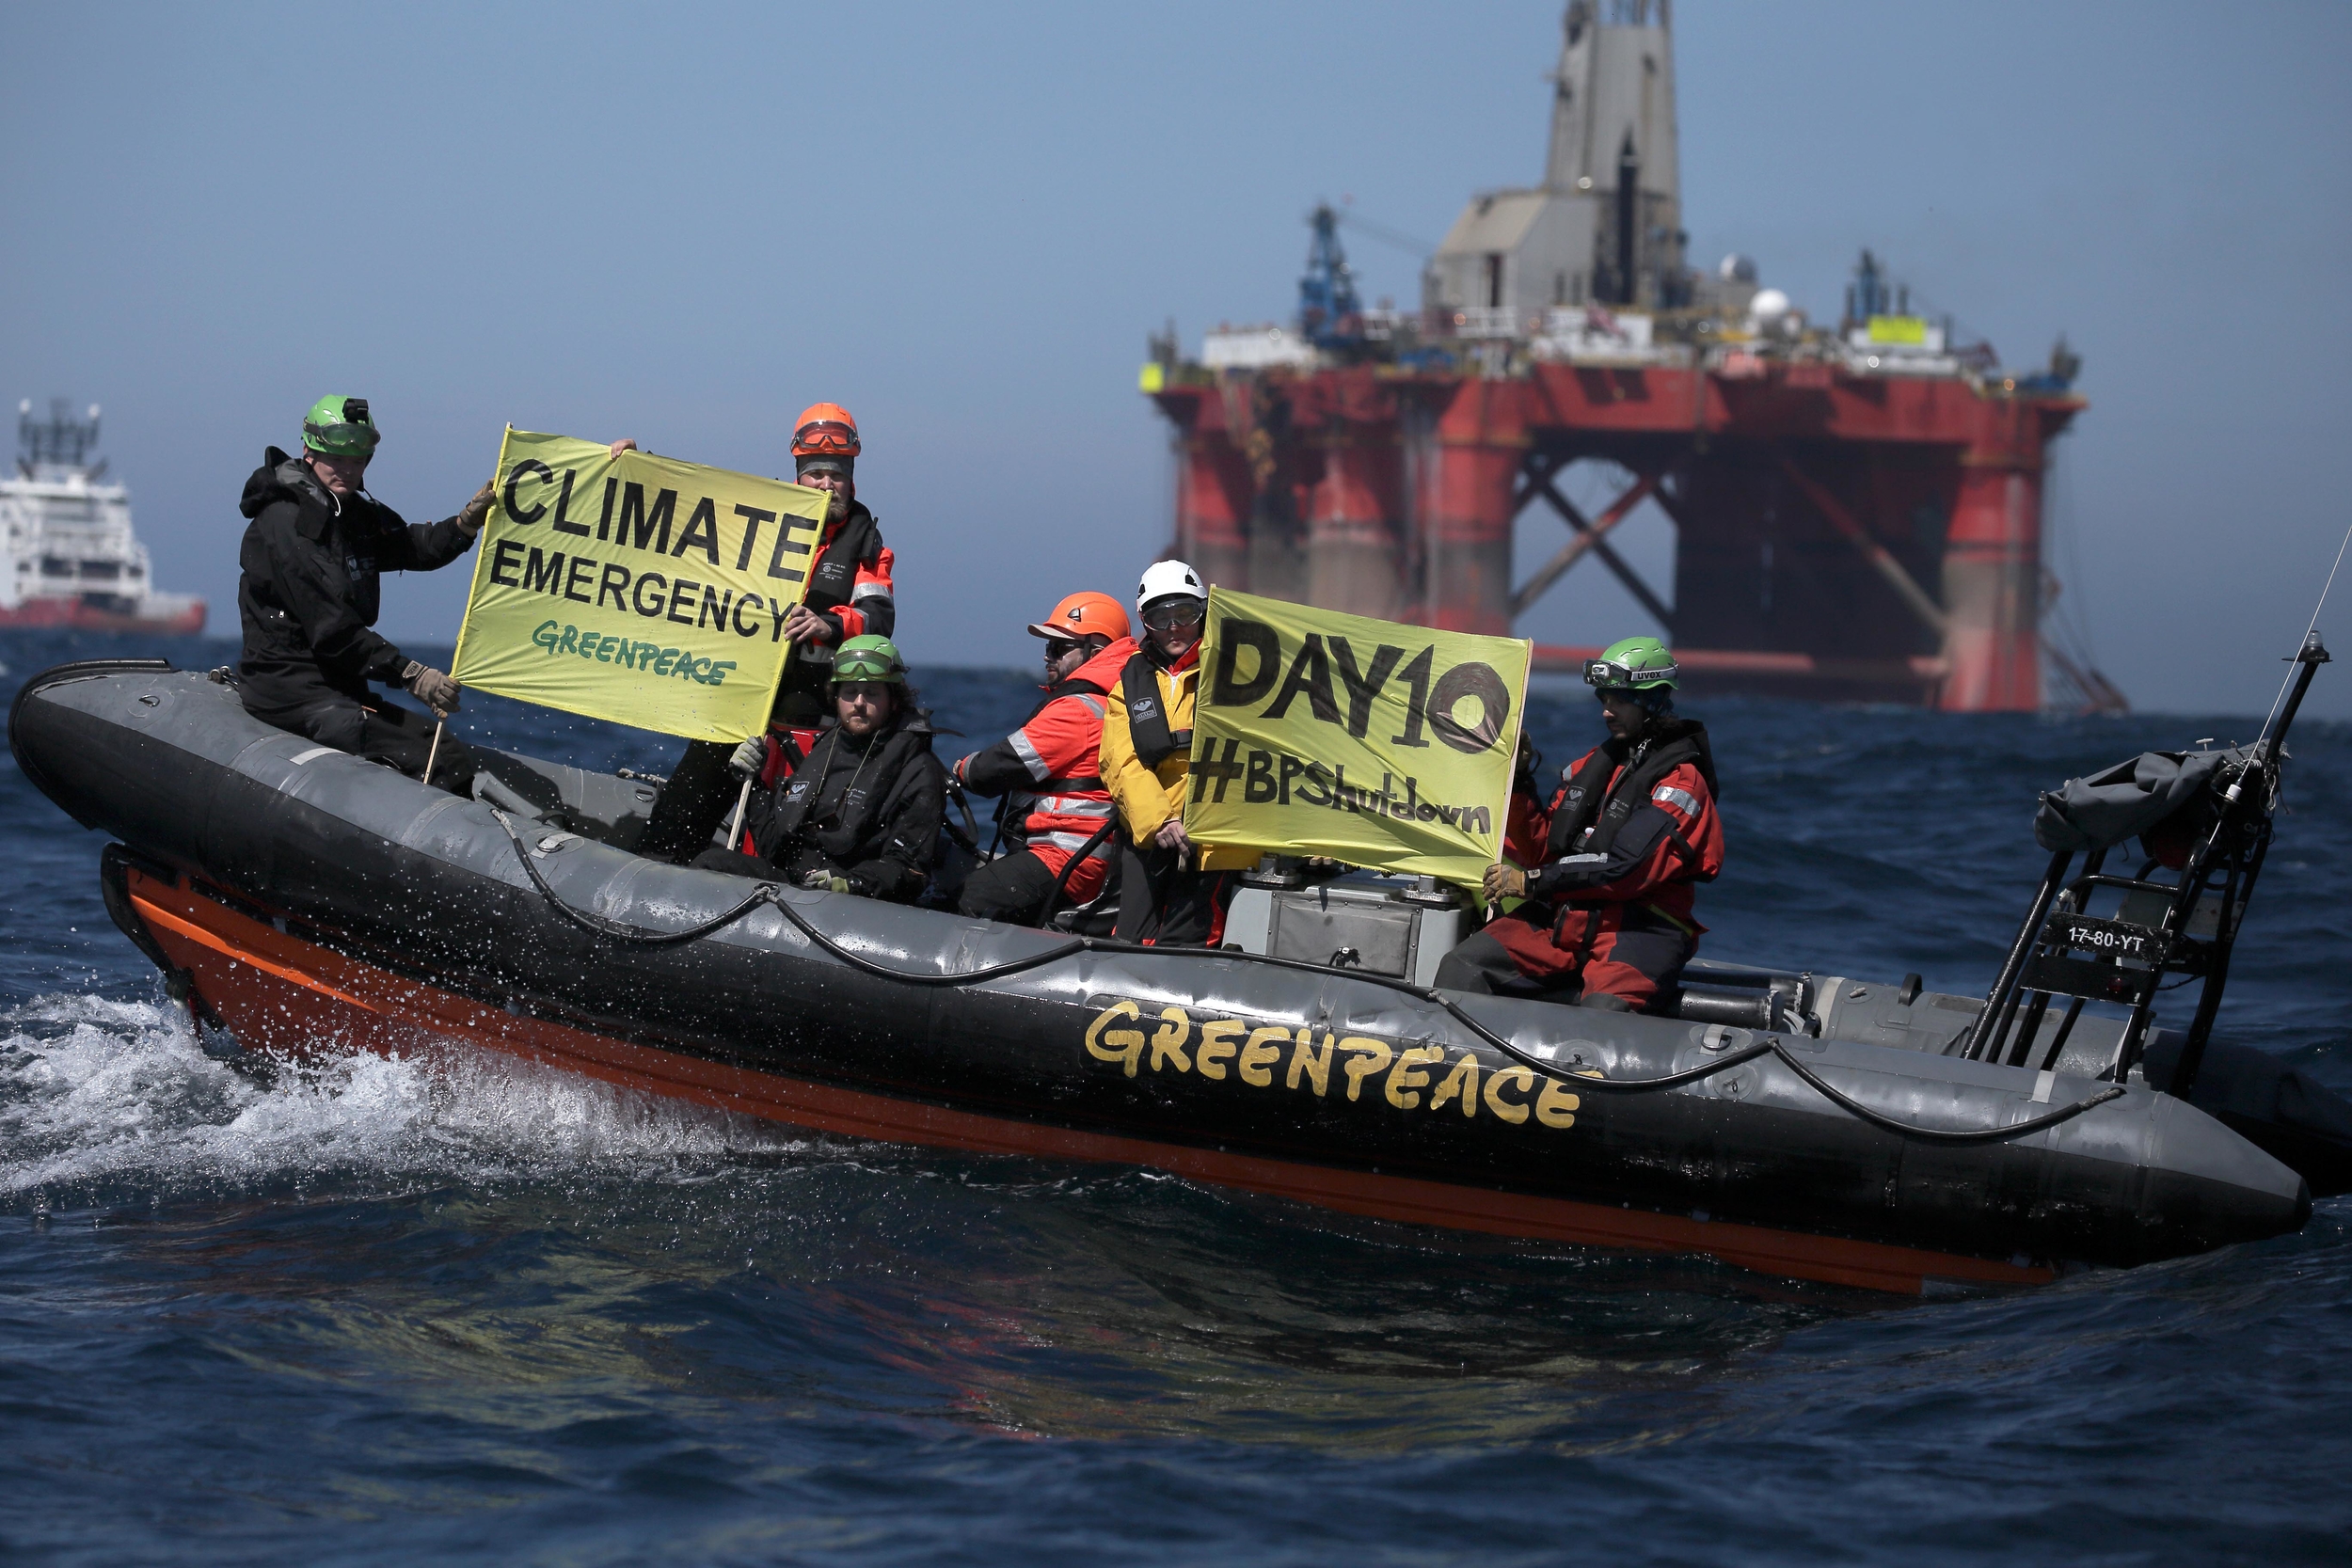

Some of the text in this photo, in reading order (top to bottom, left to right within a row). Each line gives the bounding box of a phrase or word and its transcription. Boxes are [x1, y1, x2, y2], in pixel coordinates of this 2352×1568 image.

[503, 459, 819, 583] CLIMATE
[490, 539, 796, 642] EMERGENCY
[532, 620, 737, 686] GREENPEACE
[1189, 737, 1491, 834] #BPShutdown
[2069, 927, 2144, 951] 17-80-YT
[1085, 1000, 1605, 1129] GREENPEACE
